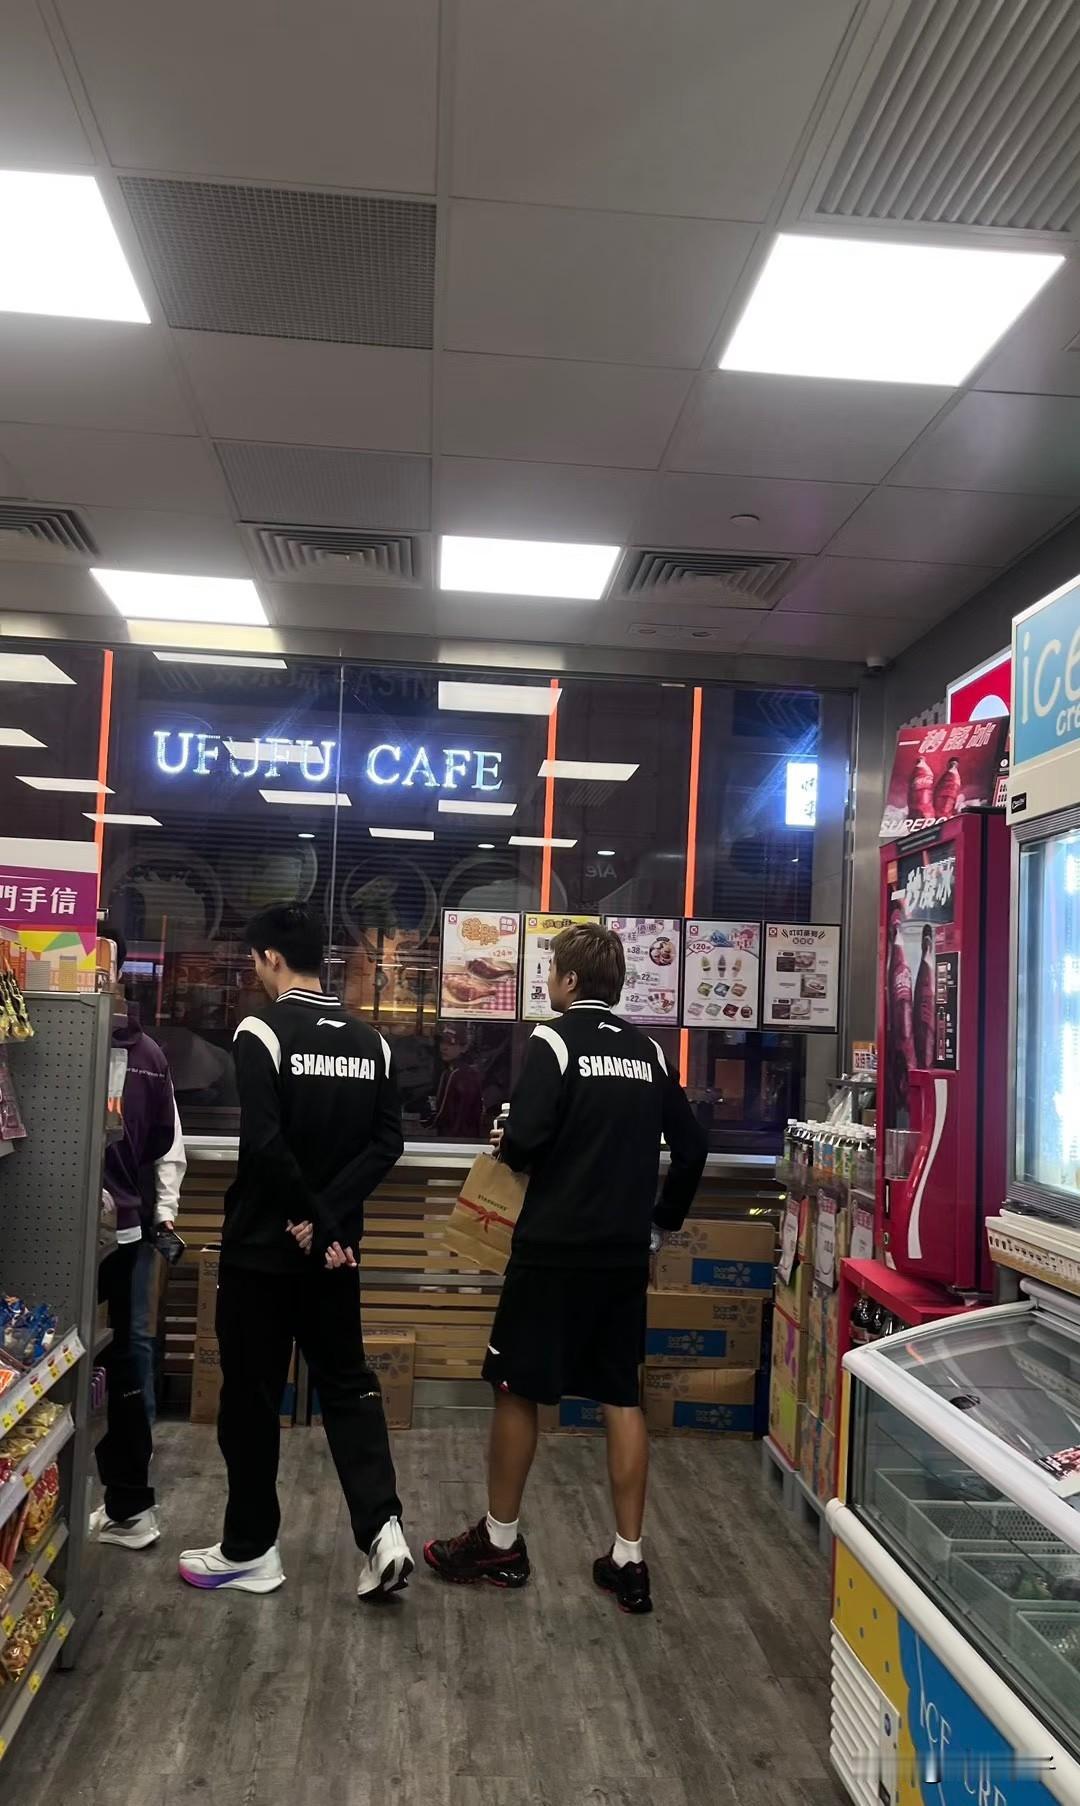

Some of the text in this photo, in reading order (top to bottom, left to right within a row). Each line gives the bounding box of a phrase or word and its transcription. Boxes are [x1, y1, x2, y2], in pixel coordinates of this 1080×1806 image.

[154, 731, 503, 791] UFUFU CAFE
[290, 1053, 375, 1080] SHANGHAI
[578, 1055, 653, 1083] SHANGHAI
